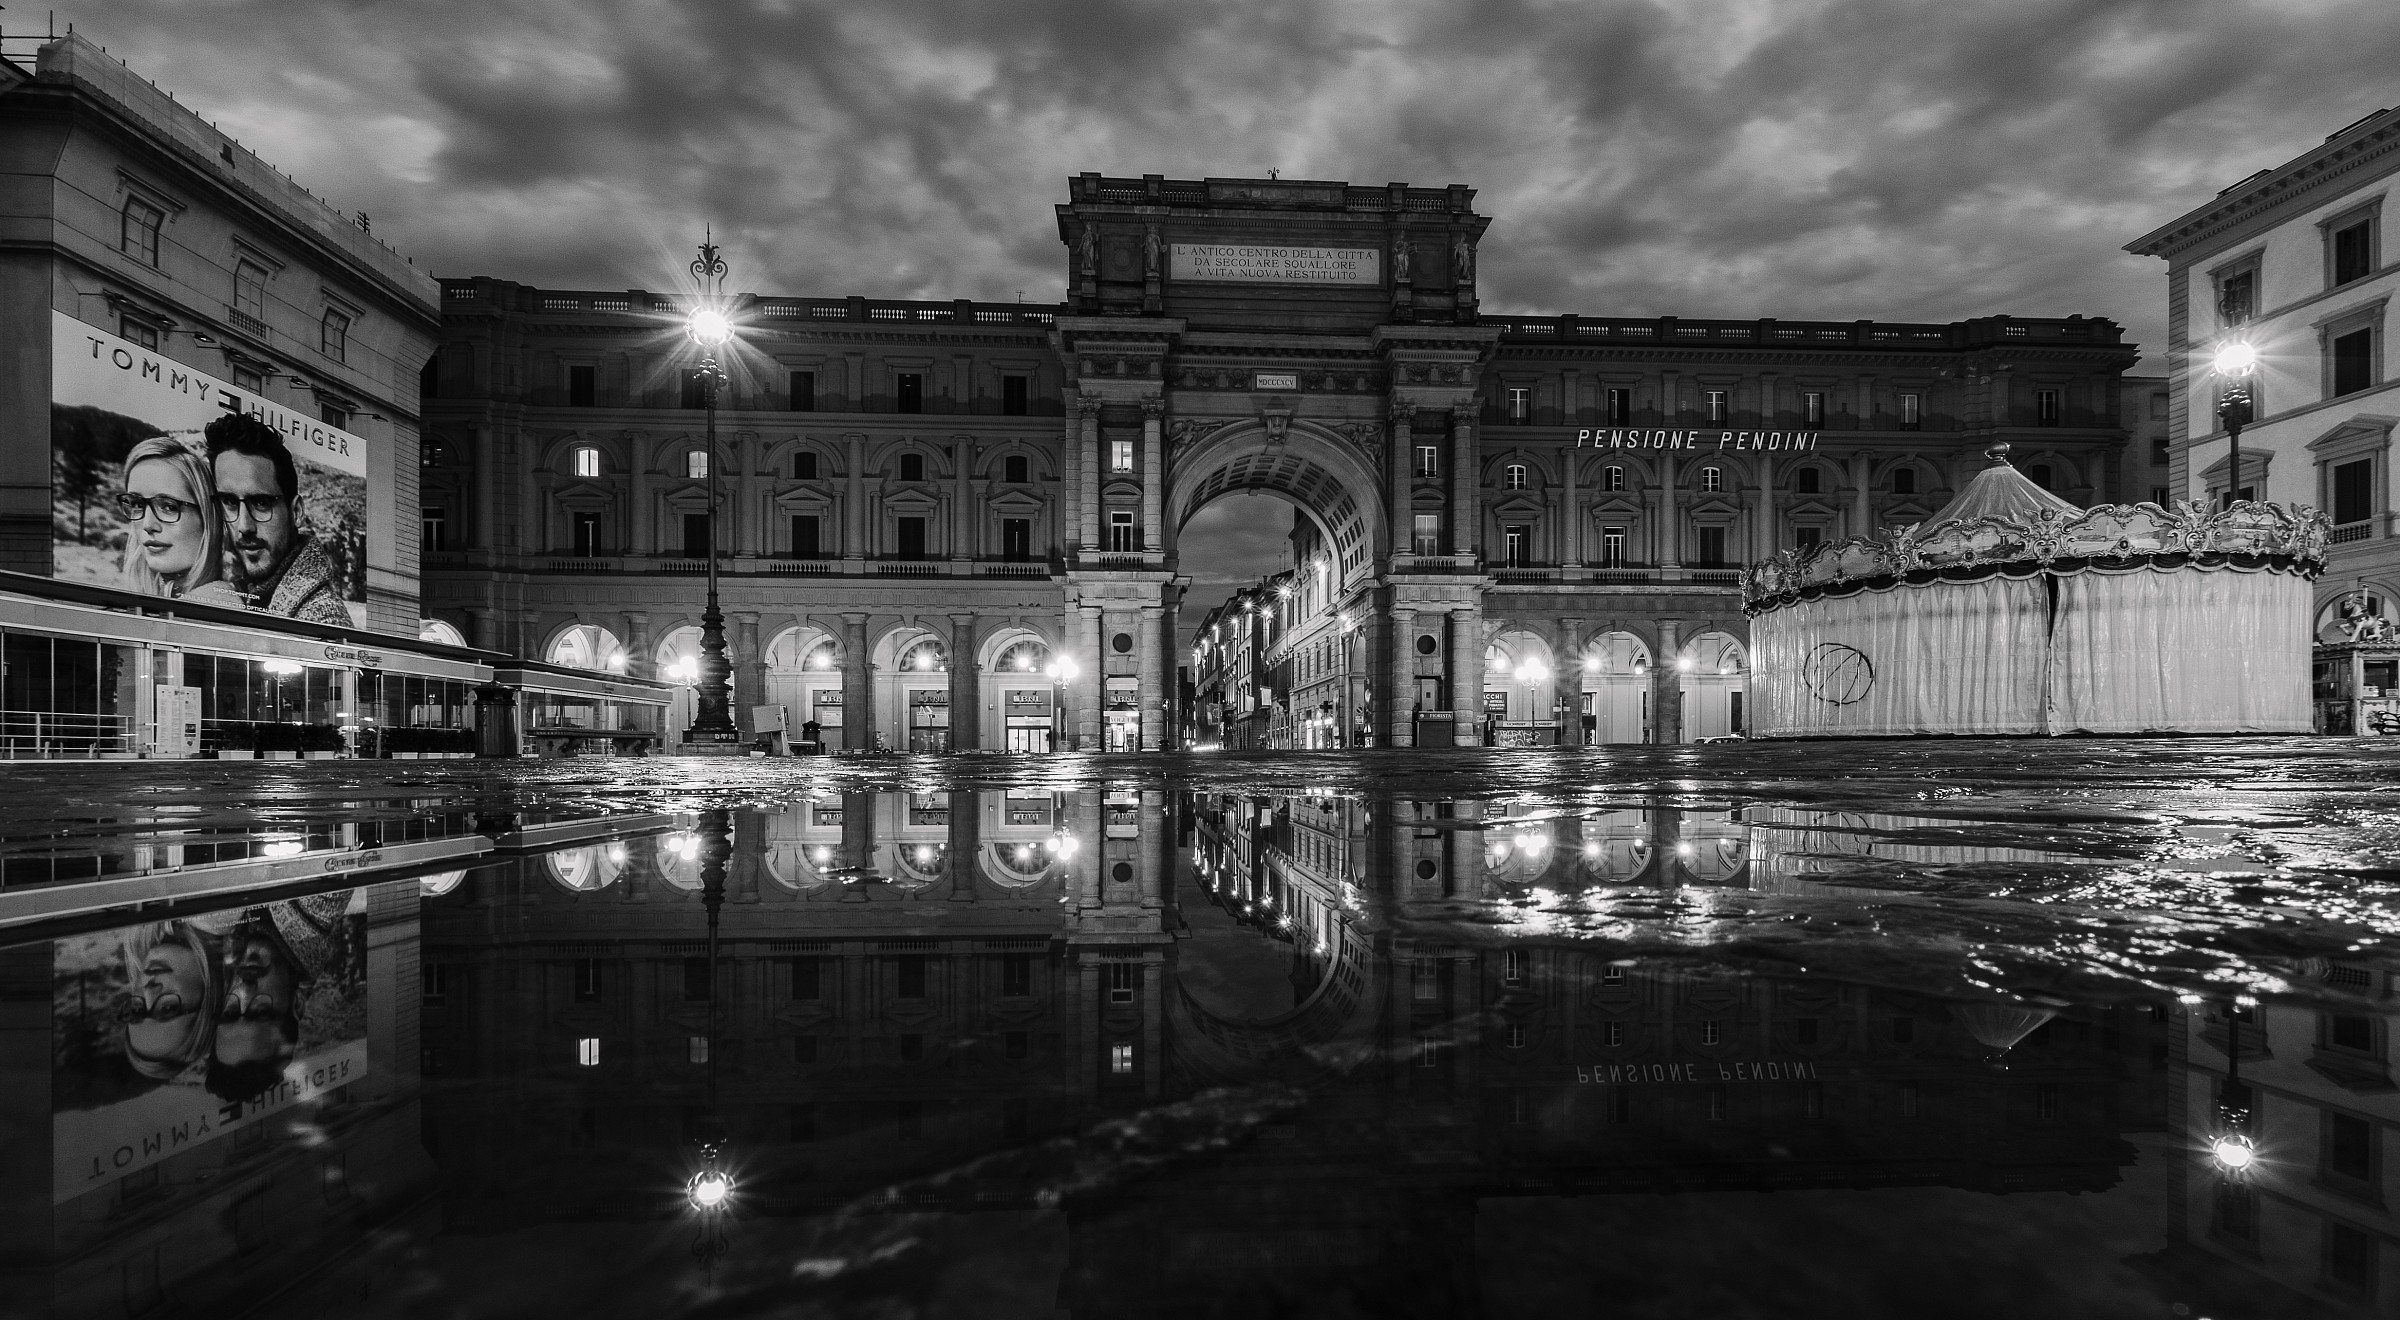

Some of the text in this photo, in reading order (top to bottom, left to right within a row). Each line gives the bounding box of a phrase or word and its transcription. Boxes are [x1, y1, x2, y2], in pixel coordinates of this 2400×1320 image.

[1177, 246, 1186, 255] L'
[1190, 247, 1235, 256] ANTICO
[1238, 248, 1288, 258] CENTRO
[1292, 249, 1333, 259] DELLA
[1194, 257, 1356, 269] DA SECOLARE SQUALLORE
[1195, 268, 1357, 280] A VITA NUOVA RESTITUITO
[87, 336, 350, 457] TOMMY HILFIGER
[1577, 429, 1818, 450] PENSIONE PENDINI
